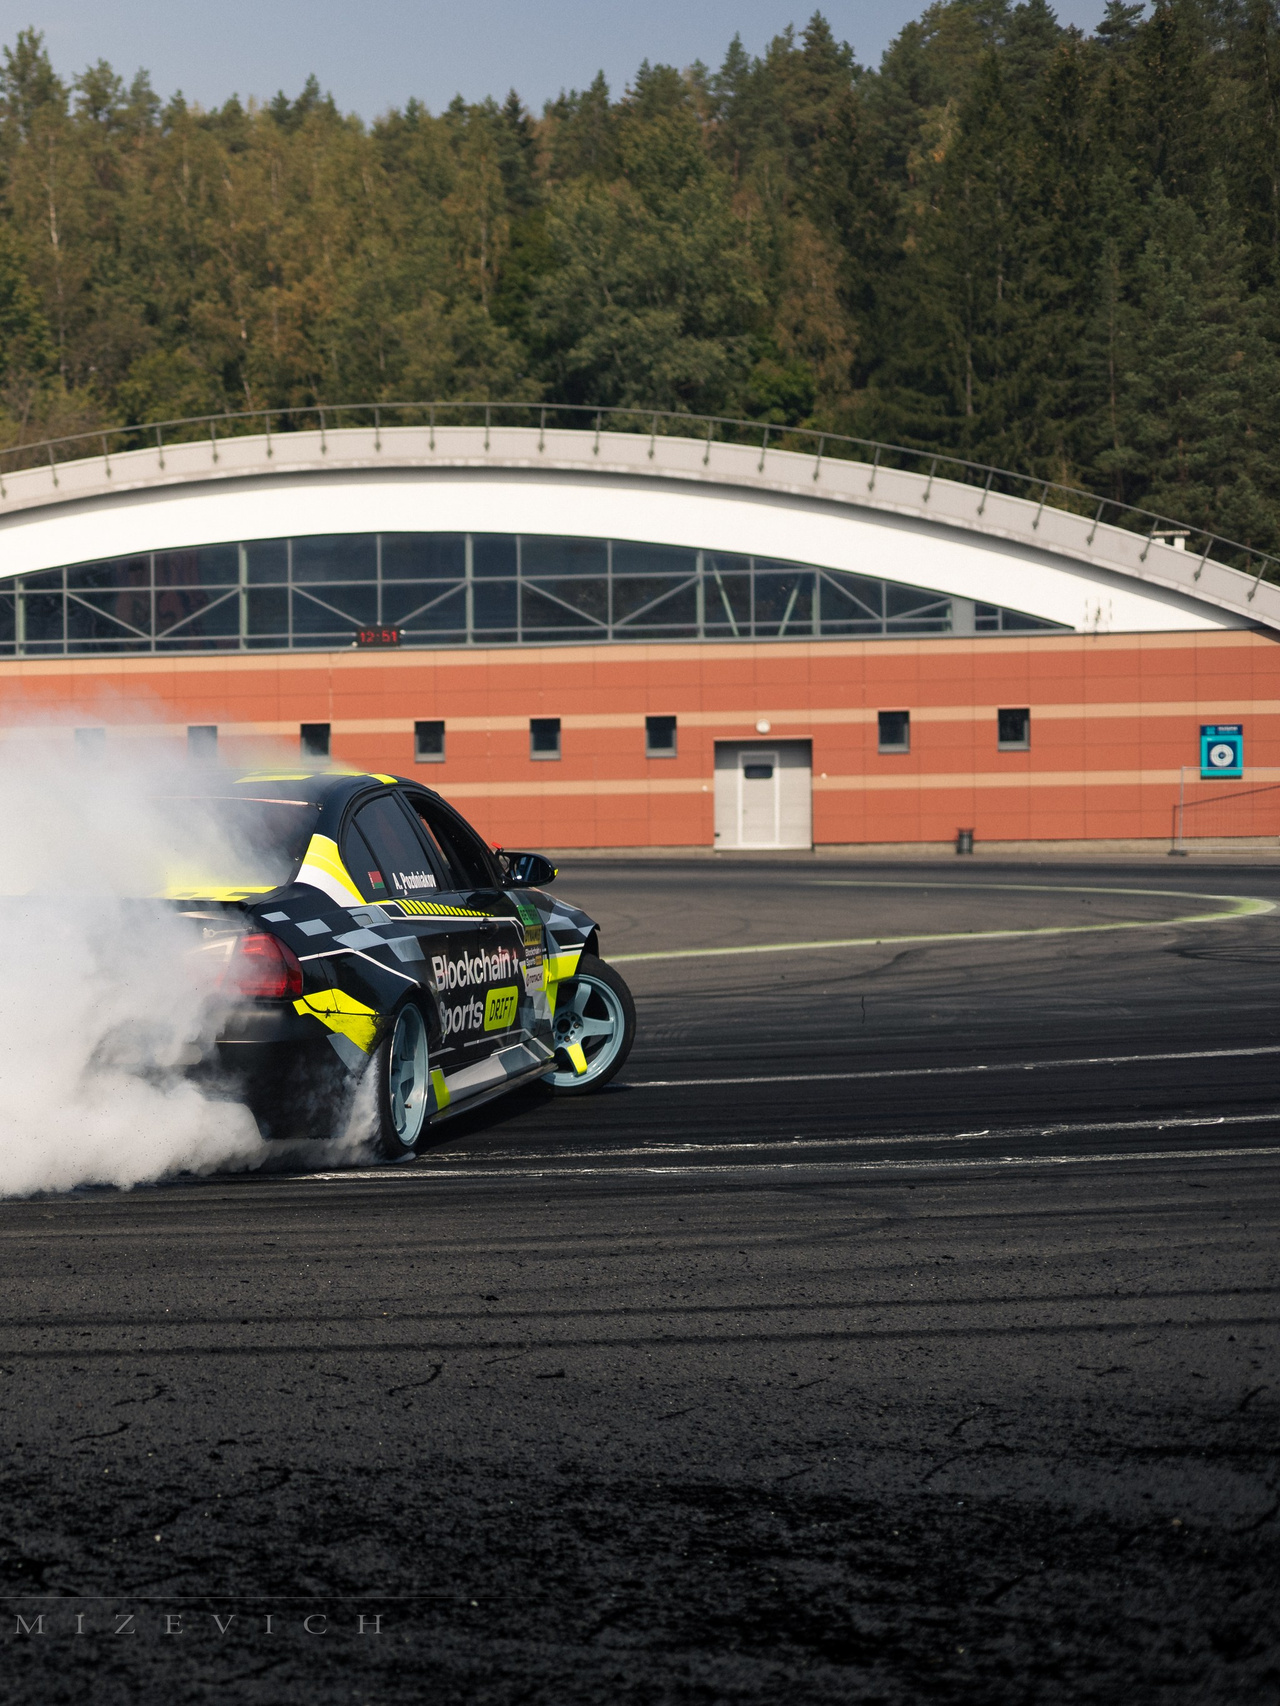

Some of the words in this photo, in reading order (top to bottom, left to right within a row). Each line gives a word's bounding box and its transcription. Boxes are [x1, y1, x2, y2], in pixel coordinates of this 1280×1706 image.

[431, 945, 512, 992] Blockchain
[440, 994, 484, 1043] Sports
[489, 996, 515, 1022] DRIFT
